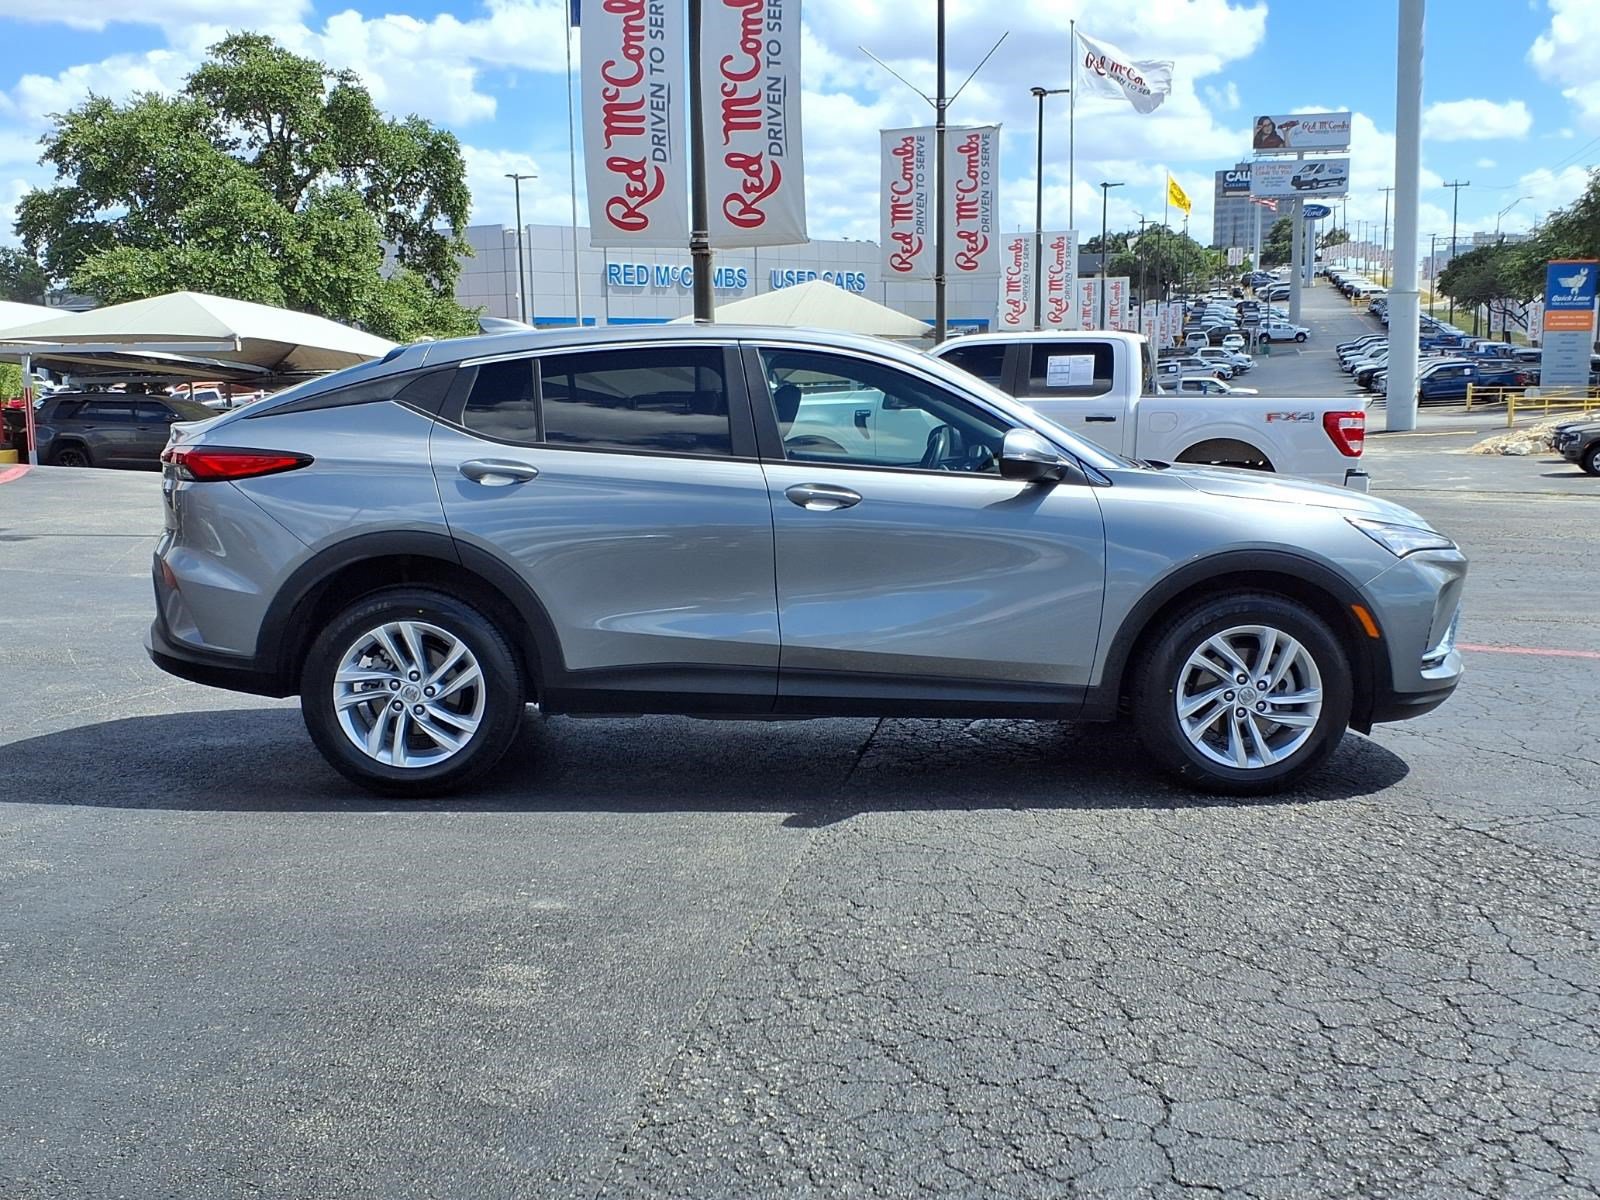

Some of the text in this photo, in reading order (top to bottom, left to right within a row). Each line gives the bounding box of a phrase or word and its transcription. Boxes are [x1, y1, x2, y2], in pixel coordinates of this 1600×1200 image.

[649, 0, 667, 163] DRIVEN TO SER
[767, 44, 782, 67] TO
[767, 77, 783, 157] DRIVEN
[606, 156, 665, 231] Red
[722, 152, 782, 228] Red
[890, 136, 923, 272] Red McCombs
[916, 135, 926, 235] DRIVEN TO SERVE
[955, 133, 988, 271] Red McCombs
[981, 133, 991, 233] DRIVEN TO SERVE
[1303, 206, 1324, 217] Ford
[607, 264, 649, 285] RED
[771, 269, 866, 291] USED CARS
[1005, 238, 1027, 324] Red McCombs
[1047, 236, 1069, 323] Red McCombs
[1265, 412, 1315, 423] FX4
